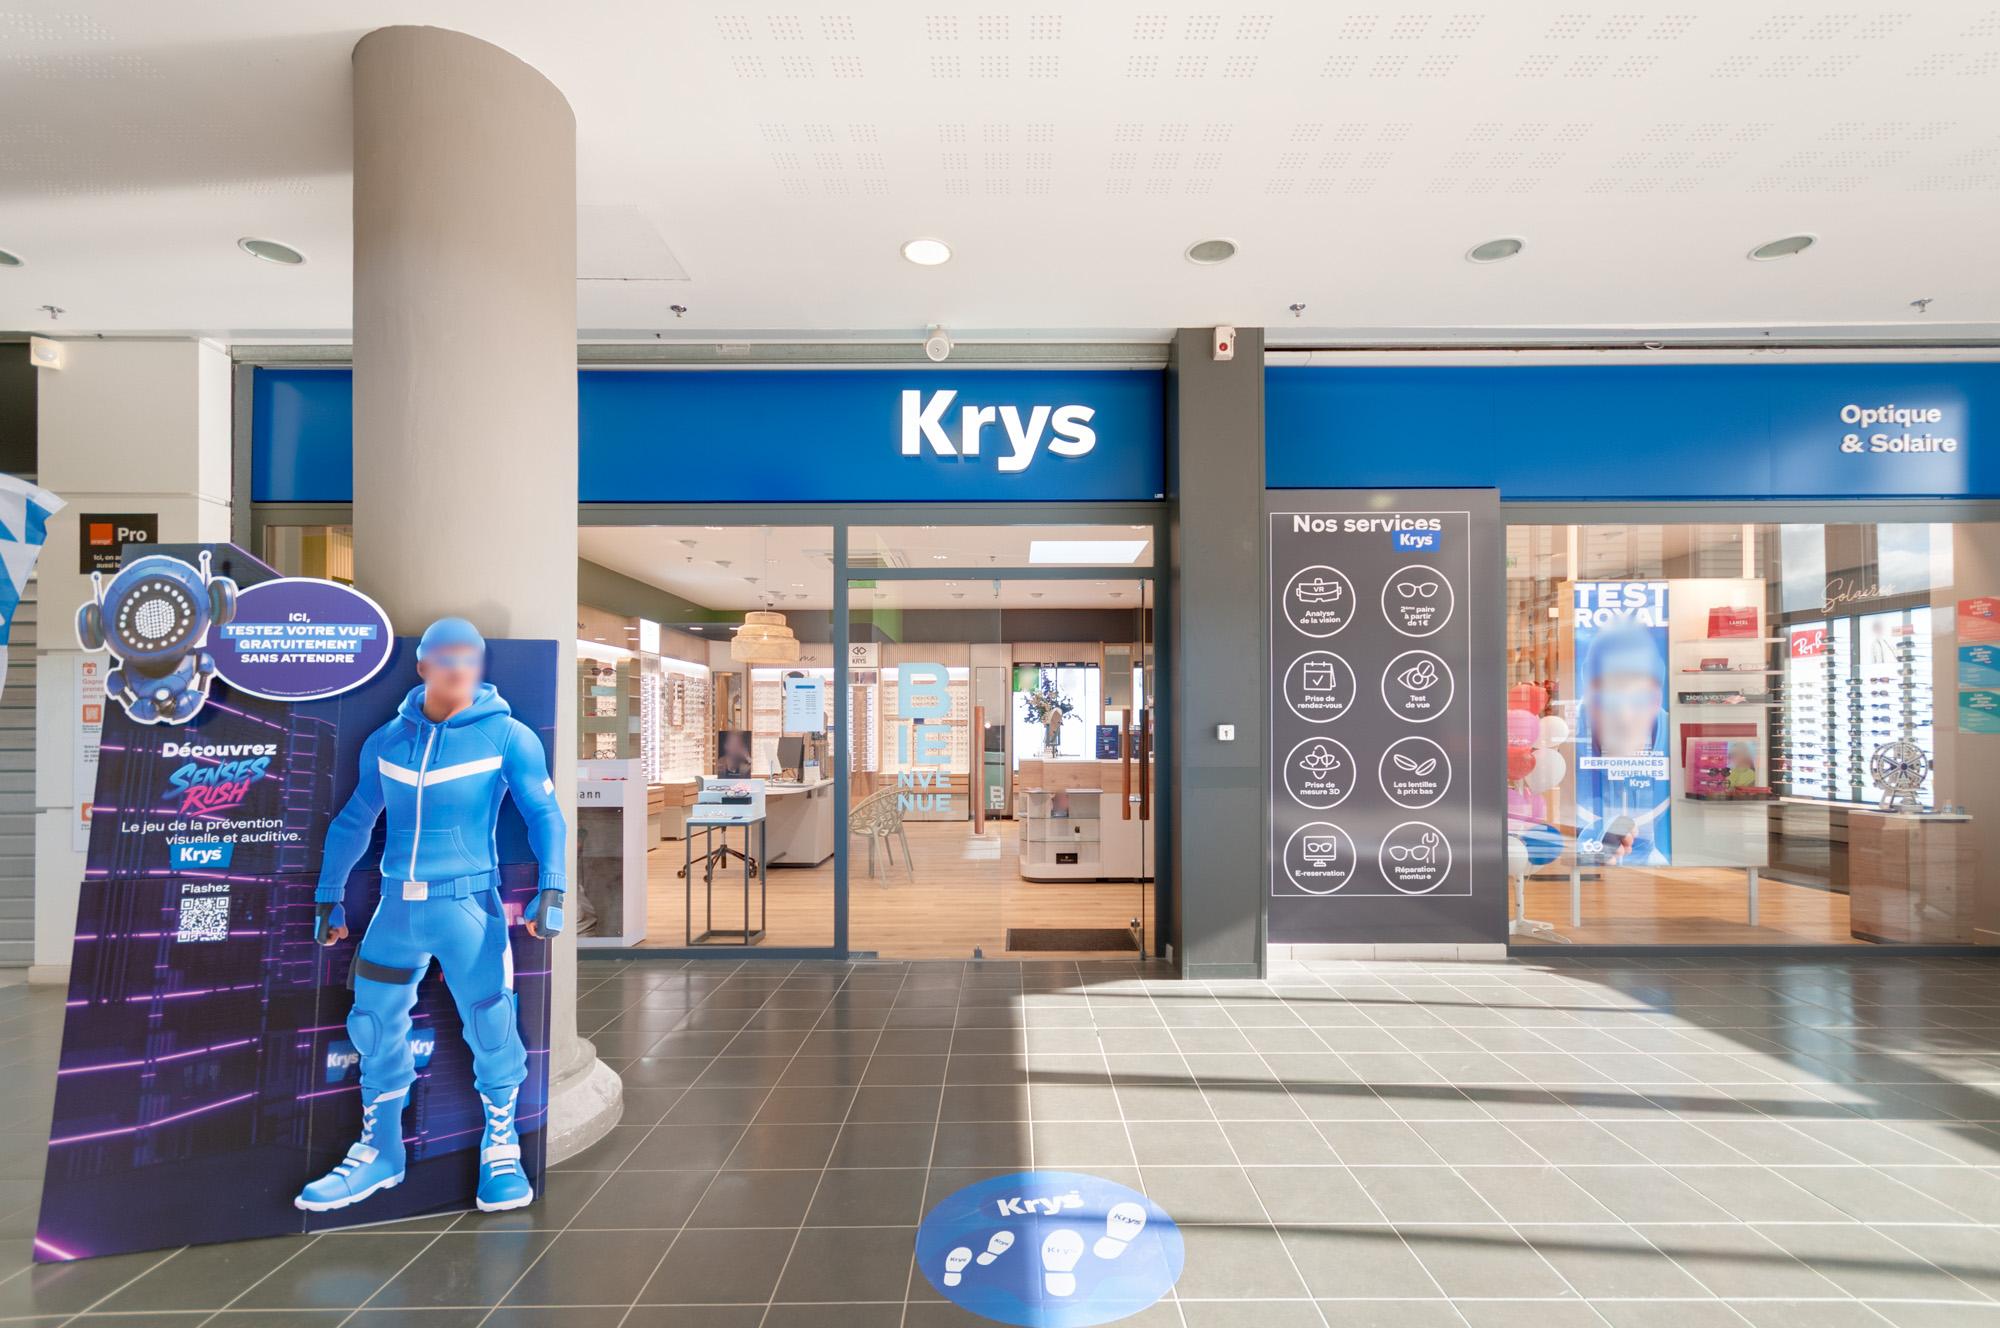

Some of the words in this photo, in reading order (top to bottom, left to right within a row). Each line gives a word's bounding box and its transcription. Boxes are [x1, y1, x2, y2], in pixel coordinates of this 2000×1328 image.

[1840, 404, 1942, 428] Optique
[902, 389, 1097, 473] Krys
[1840, 434, 1865, 453] &
[1870, 434, 1957, 453] Solaire
[1293, 515, 1338, 533] Nos
[1343, 515, 1441, 532] services
[117, 527, 148, 542] Pro
[1400, 533, 1433, 548] Krys
[1574, 582, 1669, 608] TEST
[288, 613, 311, 623] ICI,
[1305, 611, 1335, 619] Analyse
[1410, 613, 1431, 621] partir
[1416, 606, 1435, 615] paire
[1574, 608, 1669, 628] ROYAL
[226, 626, 283, 636] TESTEZ
[286, 626, 335, 636] VOTRE
[239, 639, 357, 650] GRATUITEMENT
[240, 653, 279, 663] SANS
[281, 653, 355, 663] ATTENDRE
[162, 741, 277, 758] Découvrez
[1584, 759, 1665, 767] PERFORMANCES
[162, 756, 273, 799] SENSES
[897, 770, 951, 788] NVE
[1610, 769, 1665, 777] VISUELLES
[1305, 781, 1323, 789] Prise
[1629, 779, 1650, 788] Krys
[179, 778, 250, 817] RUSH
[1403, 788, 1418, 796] prix
[897, 794, 951, 812] NUE
[121, 821, 140, 833] Le
[141, 821, 165, 835] jeu
[168, 820, 186, 832] de
[190, 819, 203, 831] la
[206, 818, 283, 834] prévention
[165, 833, 220, 845] visuelle
[223, 832, 238, 843] et
[242, 830, 301, 843] auditive.
[180, 846, 222, 863] Krys
[1395, 865, 1436, 875] Réparation
[182, 883, 230, 895] Flashez
[411, 1039, 434, 1056] Kry
[327, 1052, 359, 1069] Krys
[996, 1190, 1084, 1217] Krys
[1114, 1213, 1142, 1225] Krys
